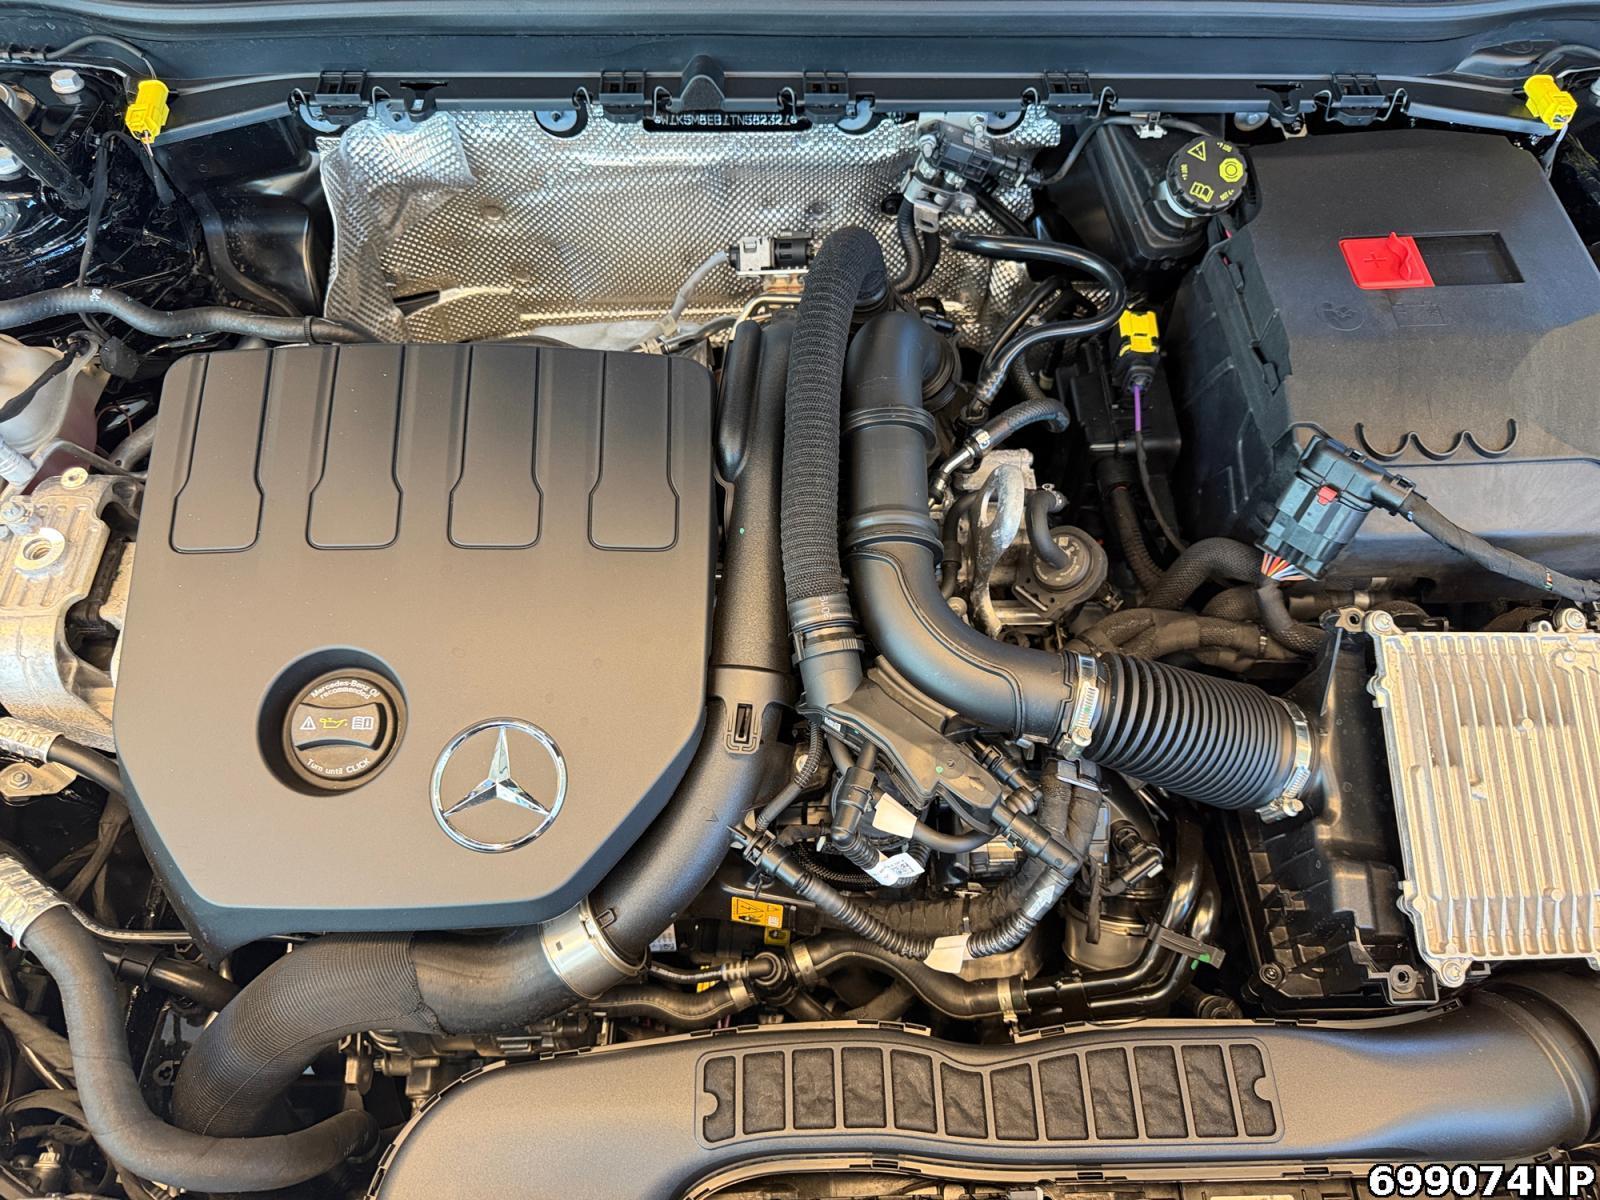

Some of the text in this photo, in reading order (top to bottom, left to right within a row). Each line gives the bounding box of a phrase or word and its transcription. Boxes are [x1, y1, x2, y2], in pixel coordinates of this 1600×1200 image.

[310, 680, 370, 698] Mercedes-Benz
[320, 687, 371, 700] recommended
[306, 757, 370, 775] Turn until CLICK
